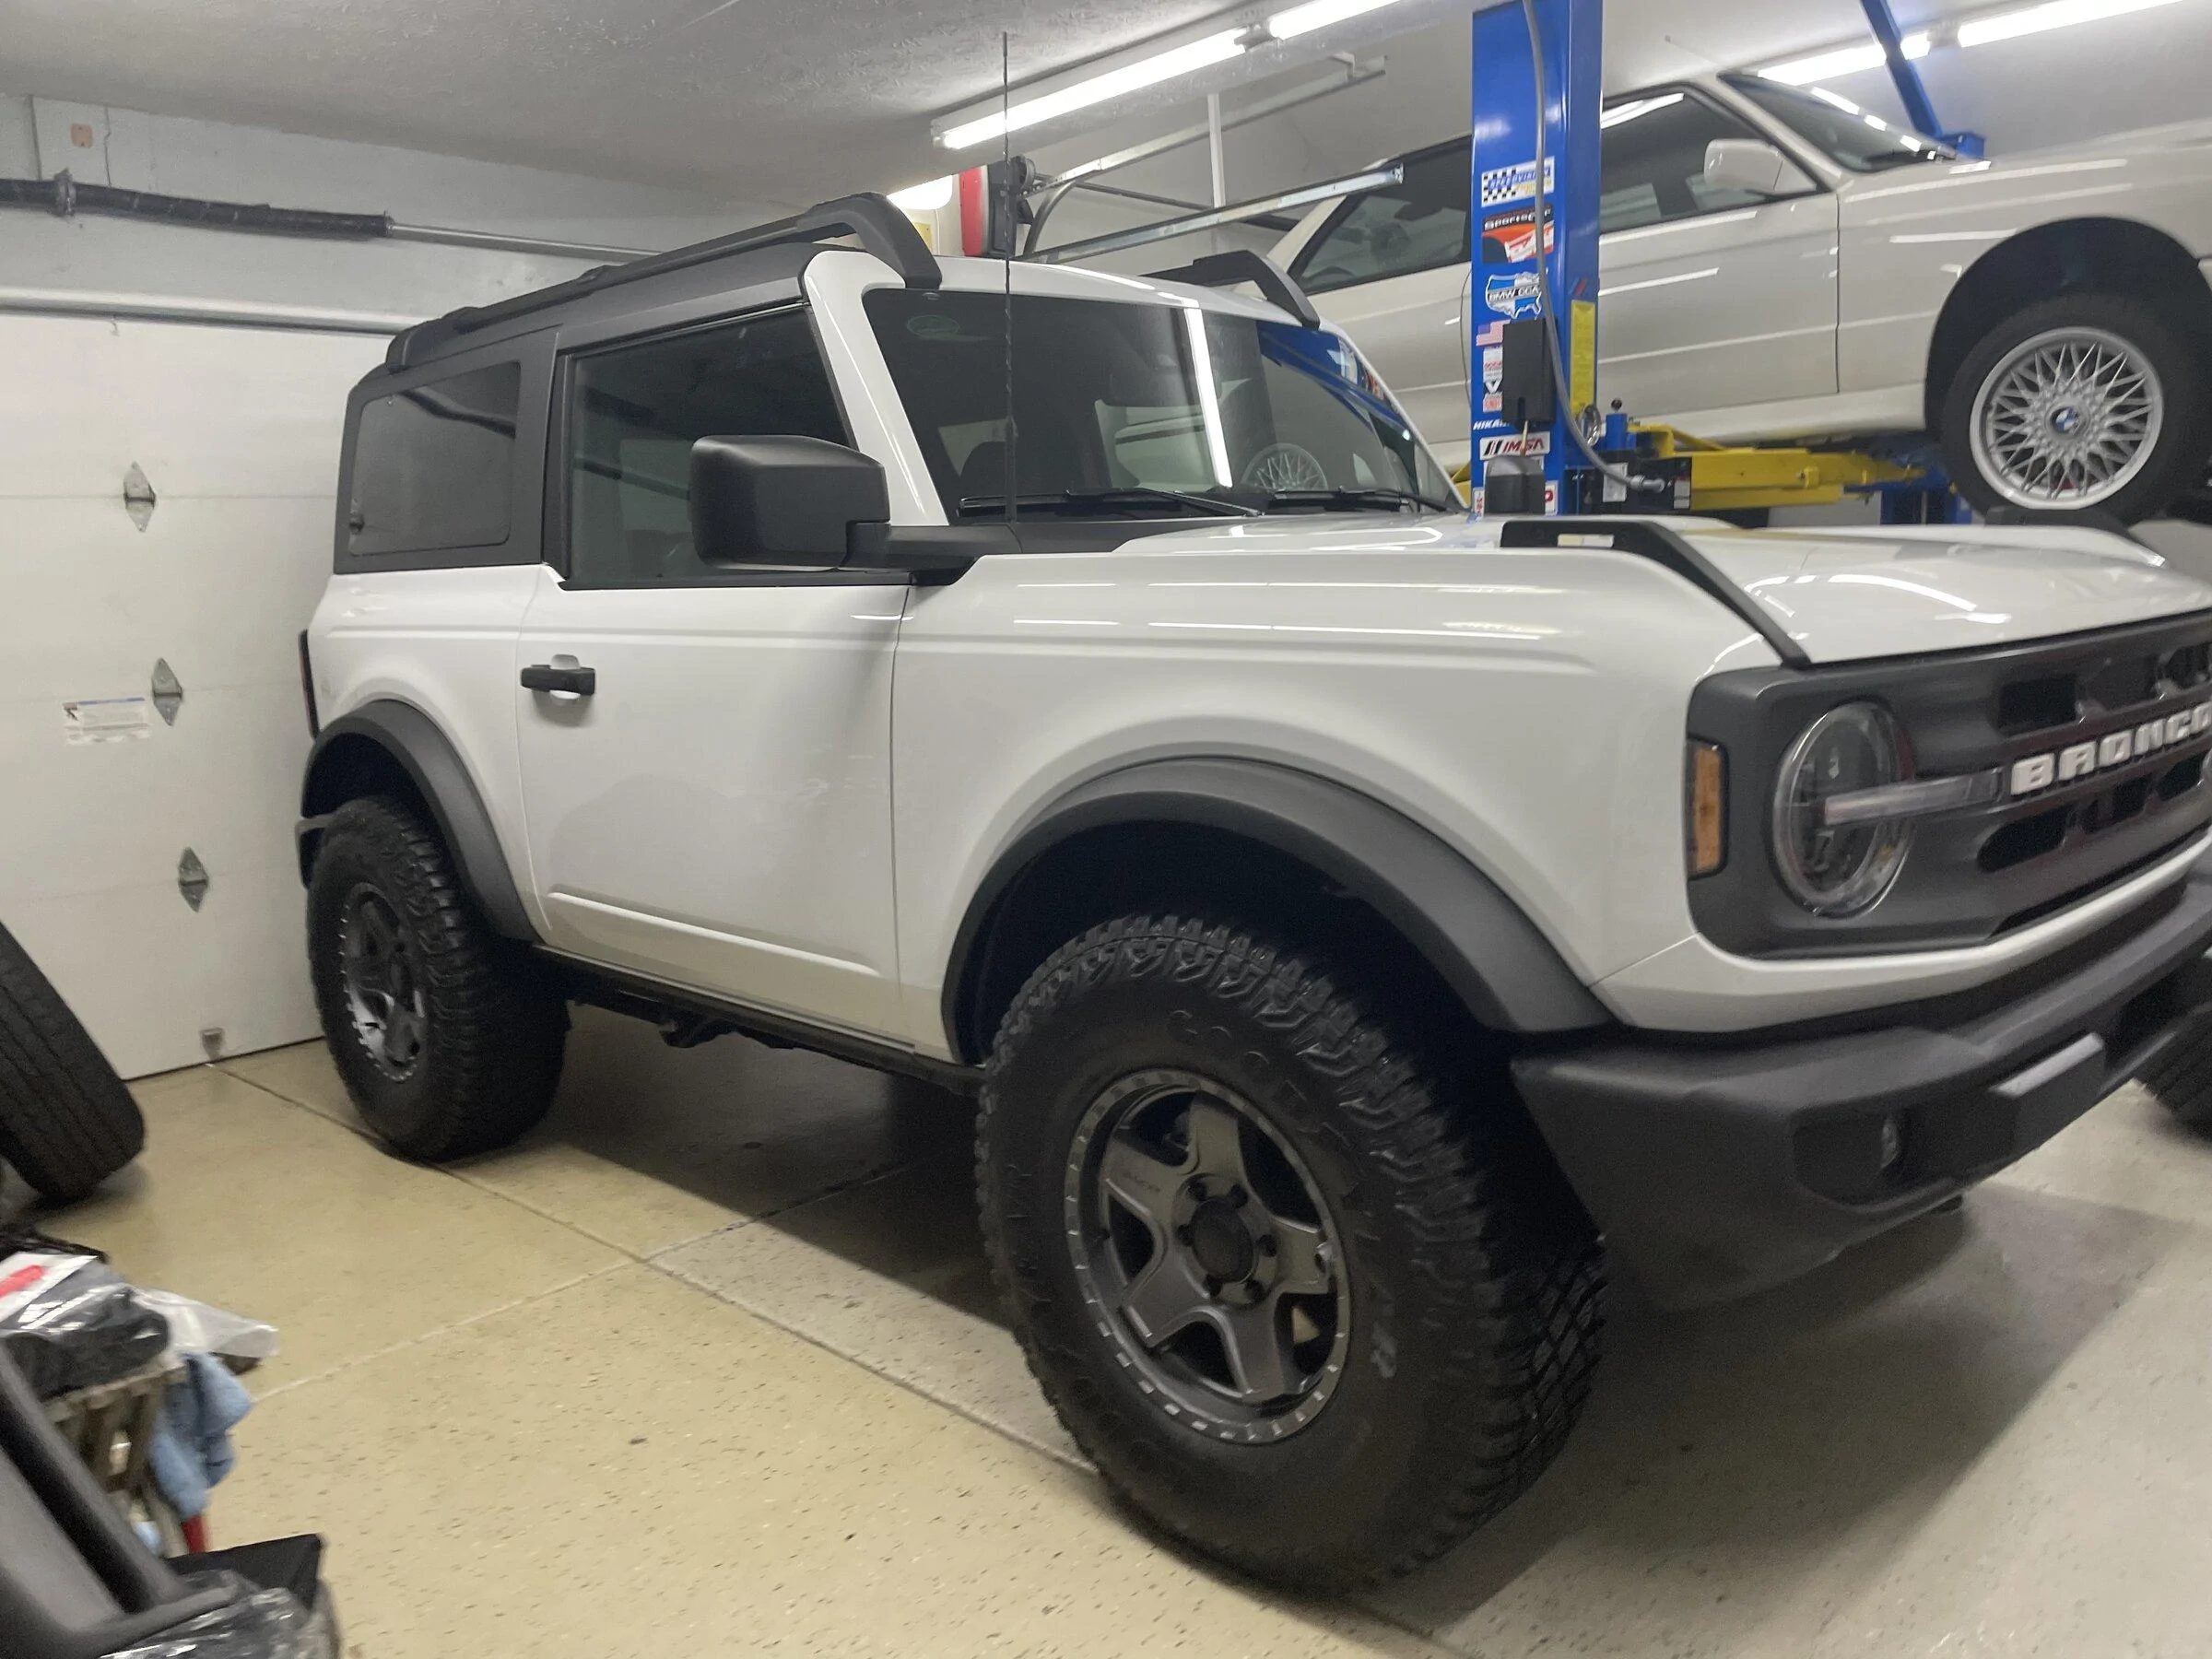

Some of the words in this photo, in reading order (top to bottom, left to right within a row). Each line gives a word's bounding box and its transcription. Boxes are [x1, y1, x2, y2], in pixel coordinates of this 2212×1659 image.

[1489, 166, 1551, 191] SPEEDVISIN
[1489, 288, 1516, 301] BMW
[1502, 438, 1545, 453] IMSA
[2010, 701, 2212, 795] BRONCO
